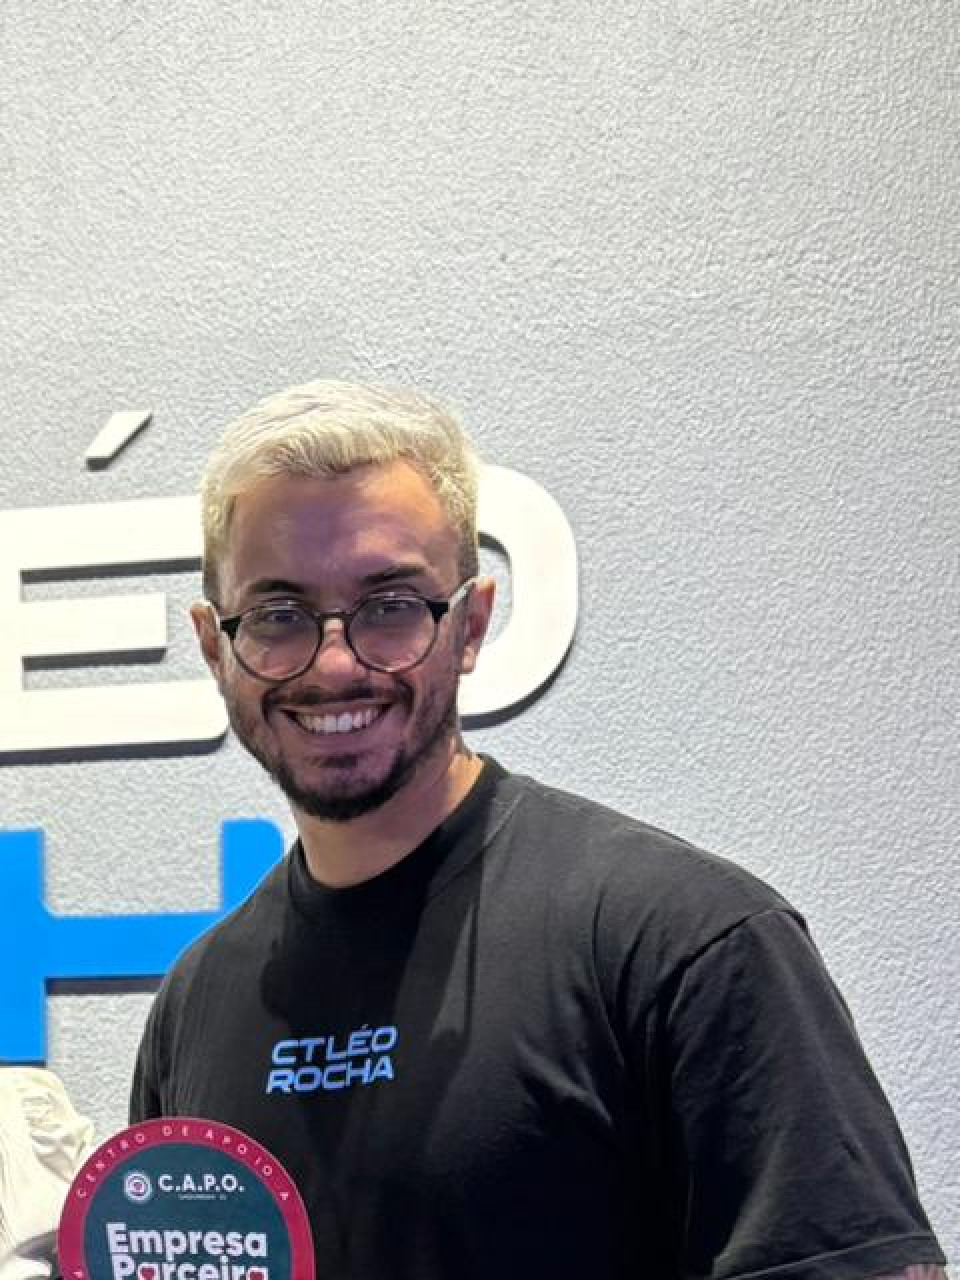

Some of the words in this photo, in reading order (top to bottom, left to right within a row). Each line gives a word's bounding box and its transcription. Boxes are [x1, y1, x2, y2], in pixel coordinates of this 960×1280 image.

[266, 1055, 394, 1094] ROCHA
[161, 1125, 190, 1138] DE
[157, 1172, 246, 1193] C.A.P.O.
[106, 1221, 269, 1262] Empresa
